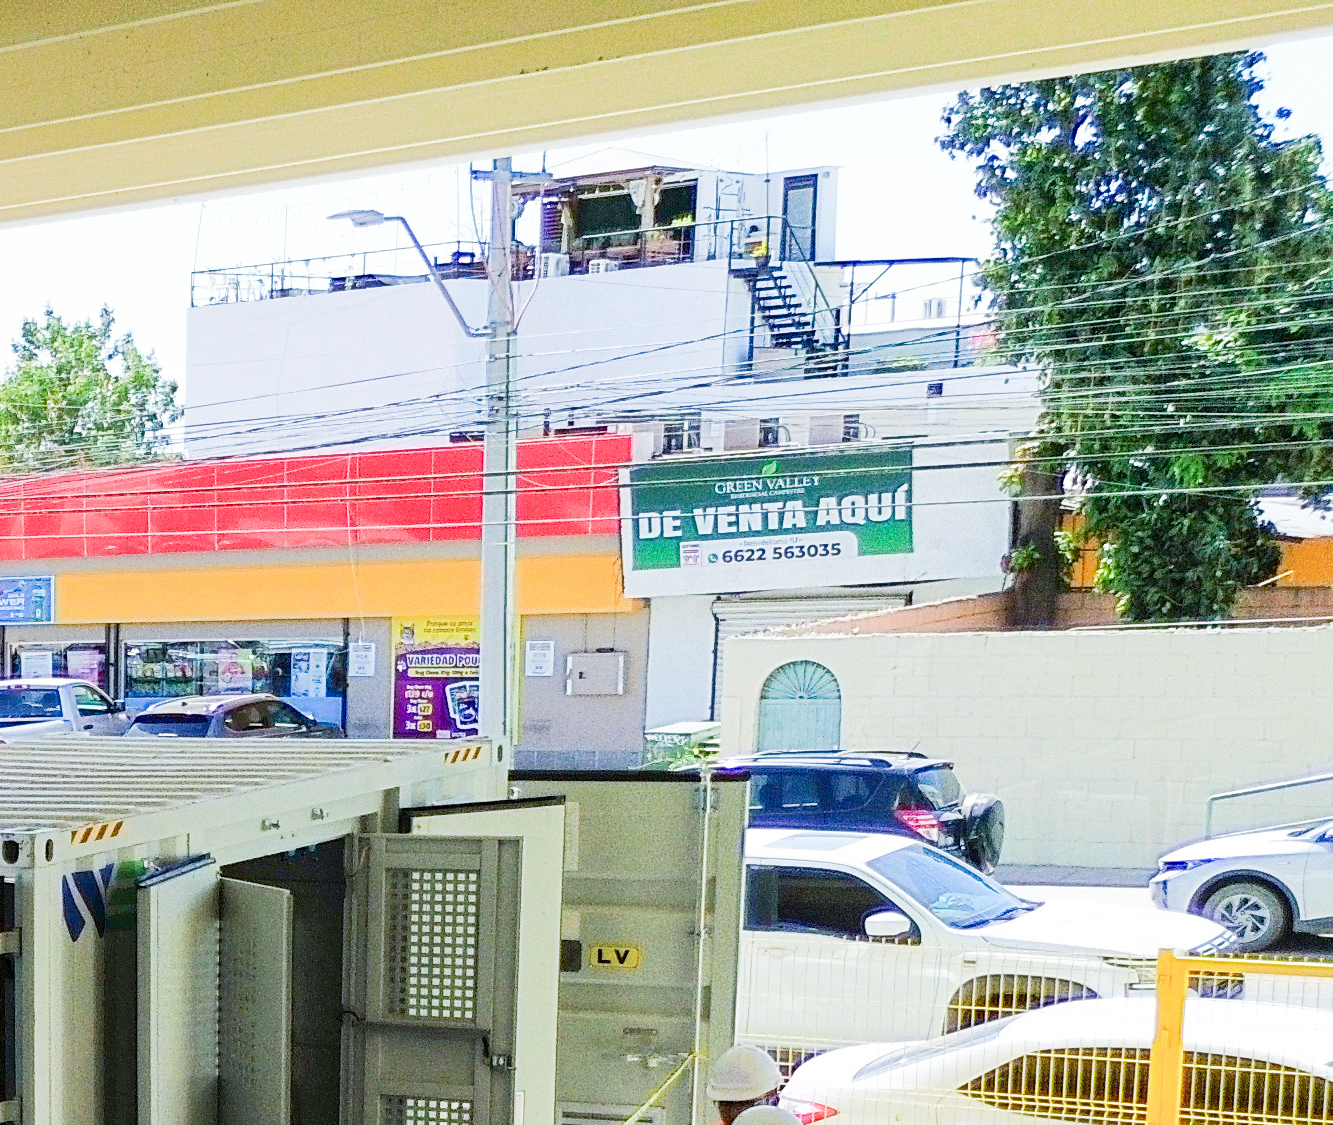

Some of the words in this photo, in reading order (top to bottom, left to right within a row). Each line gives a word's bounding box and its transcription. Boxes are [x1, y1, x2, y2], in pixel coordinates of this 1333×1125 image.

[714, 479, 763, 494] GREEN
[766, 476, 820, 491] VALLEY
[638, 510, 683, 540] DE
[693, 501, 807, 535] VENTA
[816, 483, 909, 526] AQUÍ
[722, 548, 766, 564] 6622
[772, 542, 842, 560] 563035
[407, 655, 454, 667] VARIEDAD
[597, 948, 630, 965] LV
